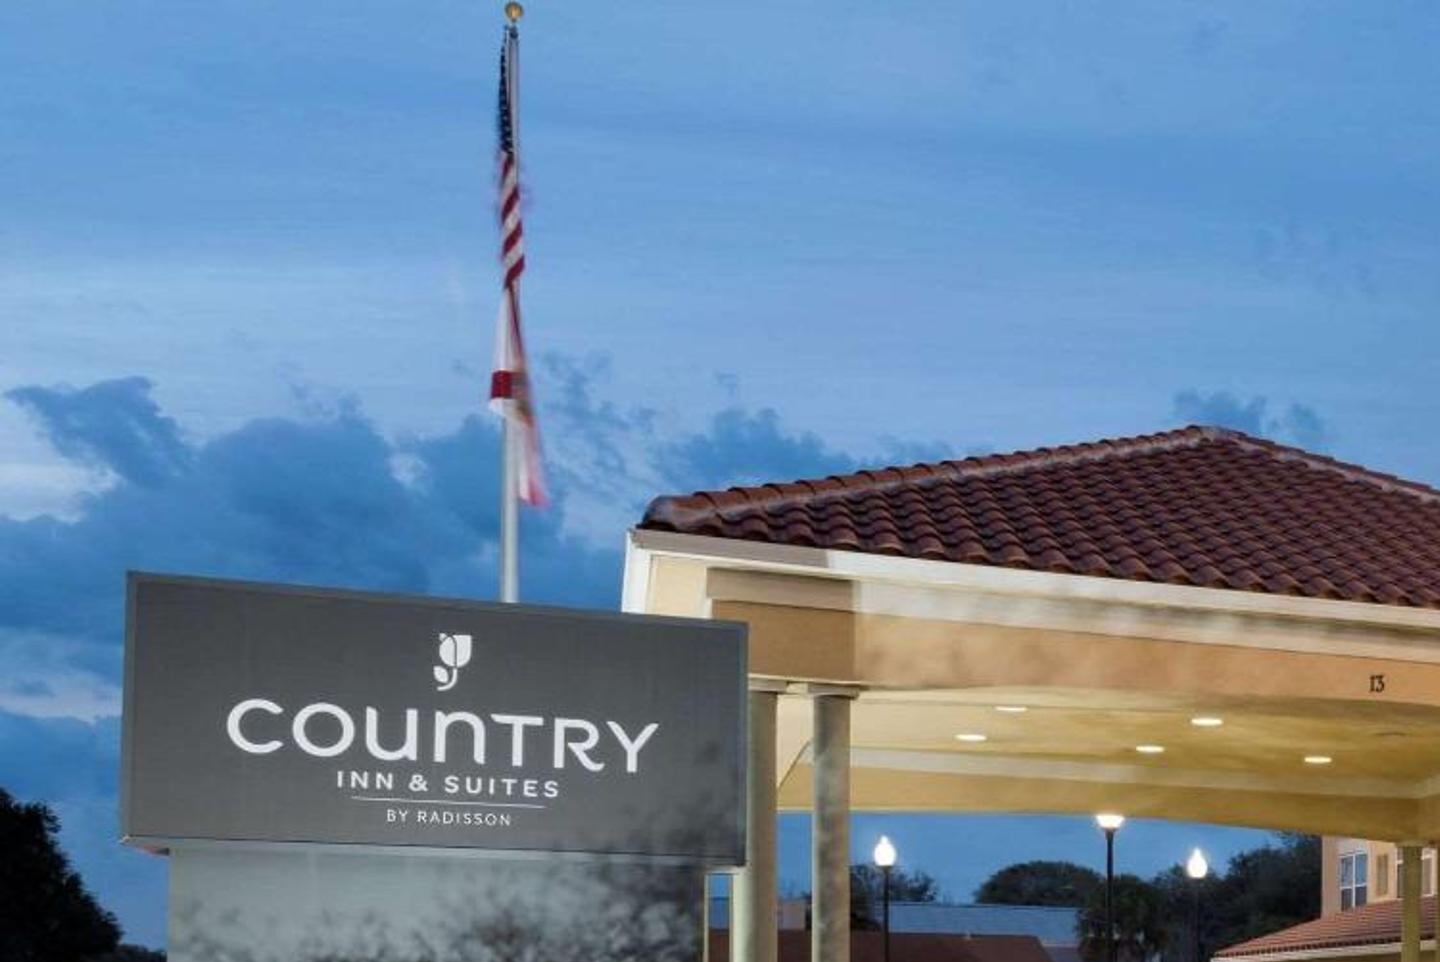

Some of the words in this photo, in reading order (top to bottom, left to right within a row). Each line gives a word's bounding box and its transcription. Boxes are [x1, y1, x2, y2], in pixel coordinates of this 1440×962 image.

[227, 699, 658, 773] COUNTRY
[337, 771, 393, 790] INN
[409, 774, 428, 792] &
[444, 775, 559, 798] SUITES
[387, 809, 408, 823] BY
[417, 811, 511, 827] RADISSON
